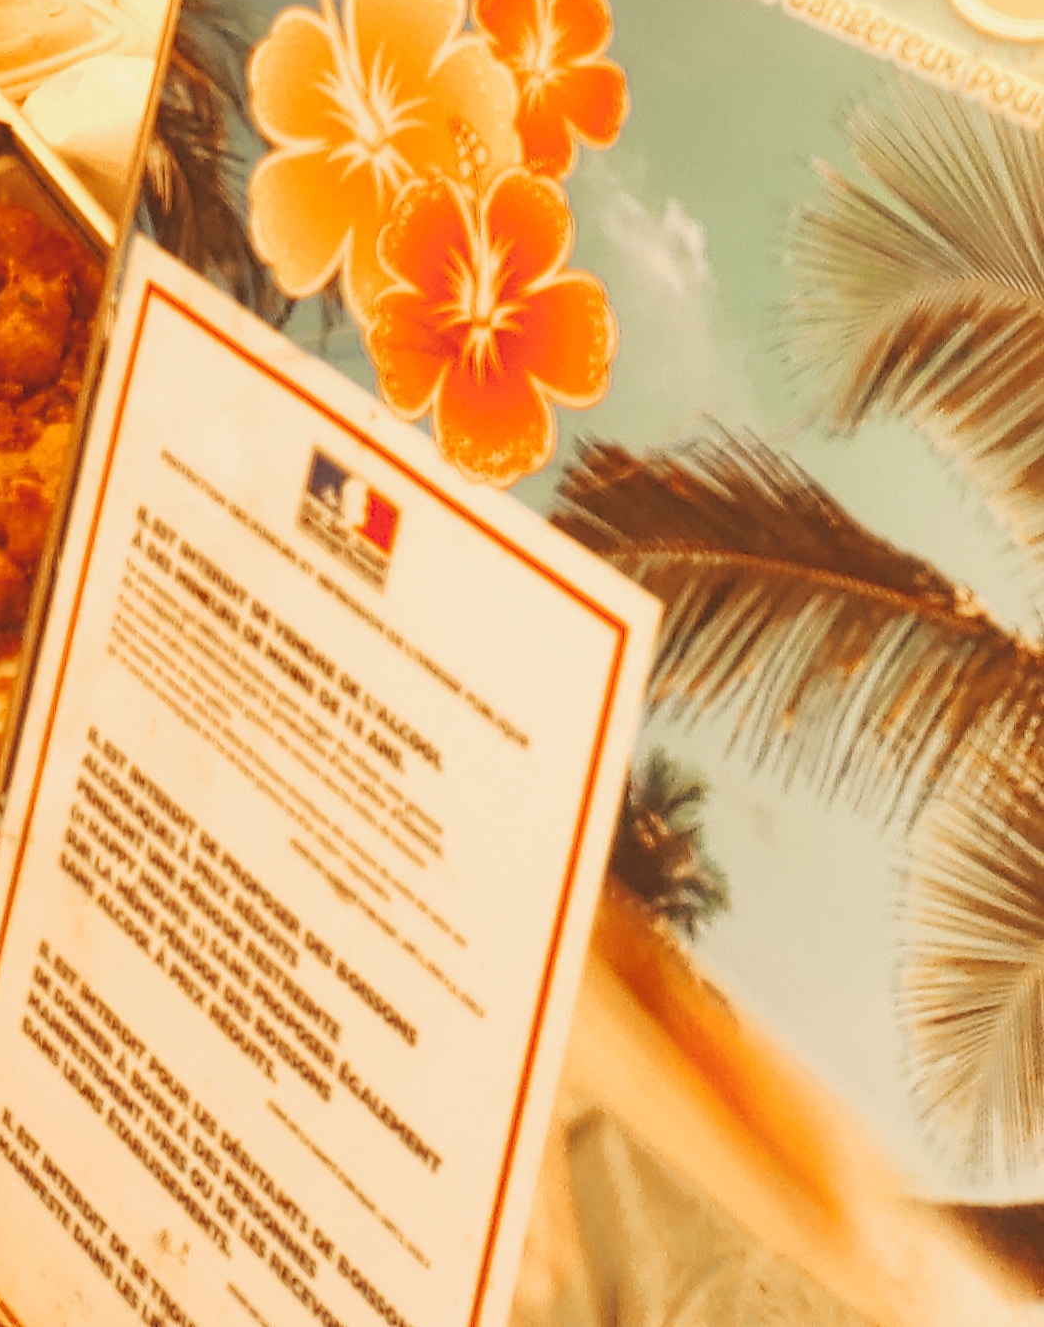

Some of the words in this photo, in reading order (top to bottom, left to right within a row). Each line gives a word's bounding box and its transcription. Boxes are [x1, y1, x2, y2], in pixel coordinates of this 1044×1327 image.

[144, 540, 172, 577] DES
[242, 622, 262, 652] DE
[317, 685, 341, 719] DE
[151, 515, 177, 550] EST
[178, 538, 249, 610] INTERDIT
[249, 596, 271, 628] DE
[337, 669, 361, 705] DE
[76, 775, 144, 853] PENDANT
[146, 843, 177, 884] UNE
[243, 937, 342, 1045] RESTREINTE
[81, 749, 178, 853] ALCOOLIQUES
[102, 737, 127, 774] EST
[127, 761, 197, 840] INTERDIT
[198, 827, 219, 861] DE
[220, 848, 301, 939] PROPOSER
[303, 927, 334, 970] DES
[334, 957, 419, 1051] BOISSONS
[58, 851, 95, 899] SANS
[97, 889, 150, 955] ALCOOL
[168, 961, 206, 1010] PRIX
[65, 826, 91, 864] SUR
[93, 854, 113, 885] LA
[222, 982, 252, 1026] DES
[253, 1013, 333, 1106] BOISSONS
[87, 818, 136, 877] HAPPY
[138, 868, 189, 929] HOURS
[208, 937, 251, 990] SANS
[252, 980, 335, 1074] PROPOSER
[337, 1057, 444, 1179] ÉGALEMENT
[21, 1015, 61, 1070] DANS
[62, 1059, 104, 1117] LEURS
[26, 989, 145, 1127] MANIFESTEMENT
[188, 1164, 214, 1204] OU
[215, 1193, 237, 1229] DE
[239, 1219, 267, 1262] LES
[32, 964, 52, 996] DE
[53, 986, 114, 1063] DONNER
[130, 1068, 176, 1128] BOIRE
[192, 1134, 221, 1178] DES
[222, 1167, 317, 1281] PERSONNES
[52, 953, 78, 992] EST
[79, 981, 146, 1064] INTERDIT
[147, 1052, 189, 1109] POUR
[192, 1099, 218, 1140] LES
[311, 1226, 335, 1264] DE
[15, 1122, 41, 1163] EST
[41, 1153, 108, 1241] INTERDIT
[109, 1230, 130, 1267] DE
[129, 1255, 149, 1290] SE
[72, 1221, 116, 1284] DANS
[115, 1271, 141, 1314] LES
